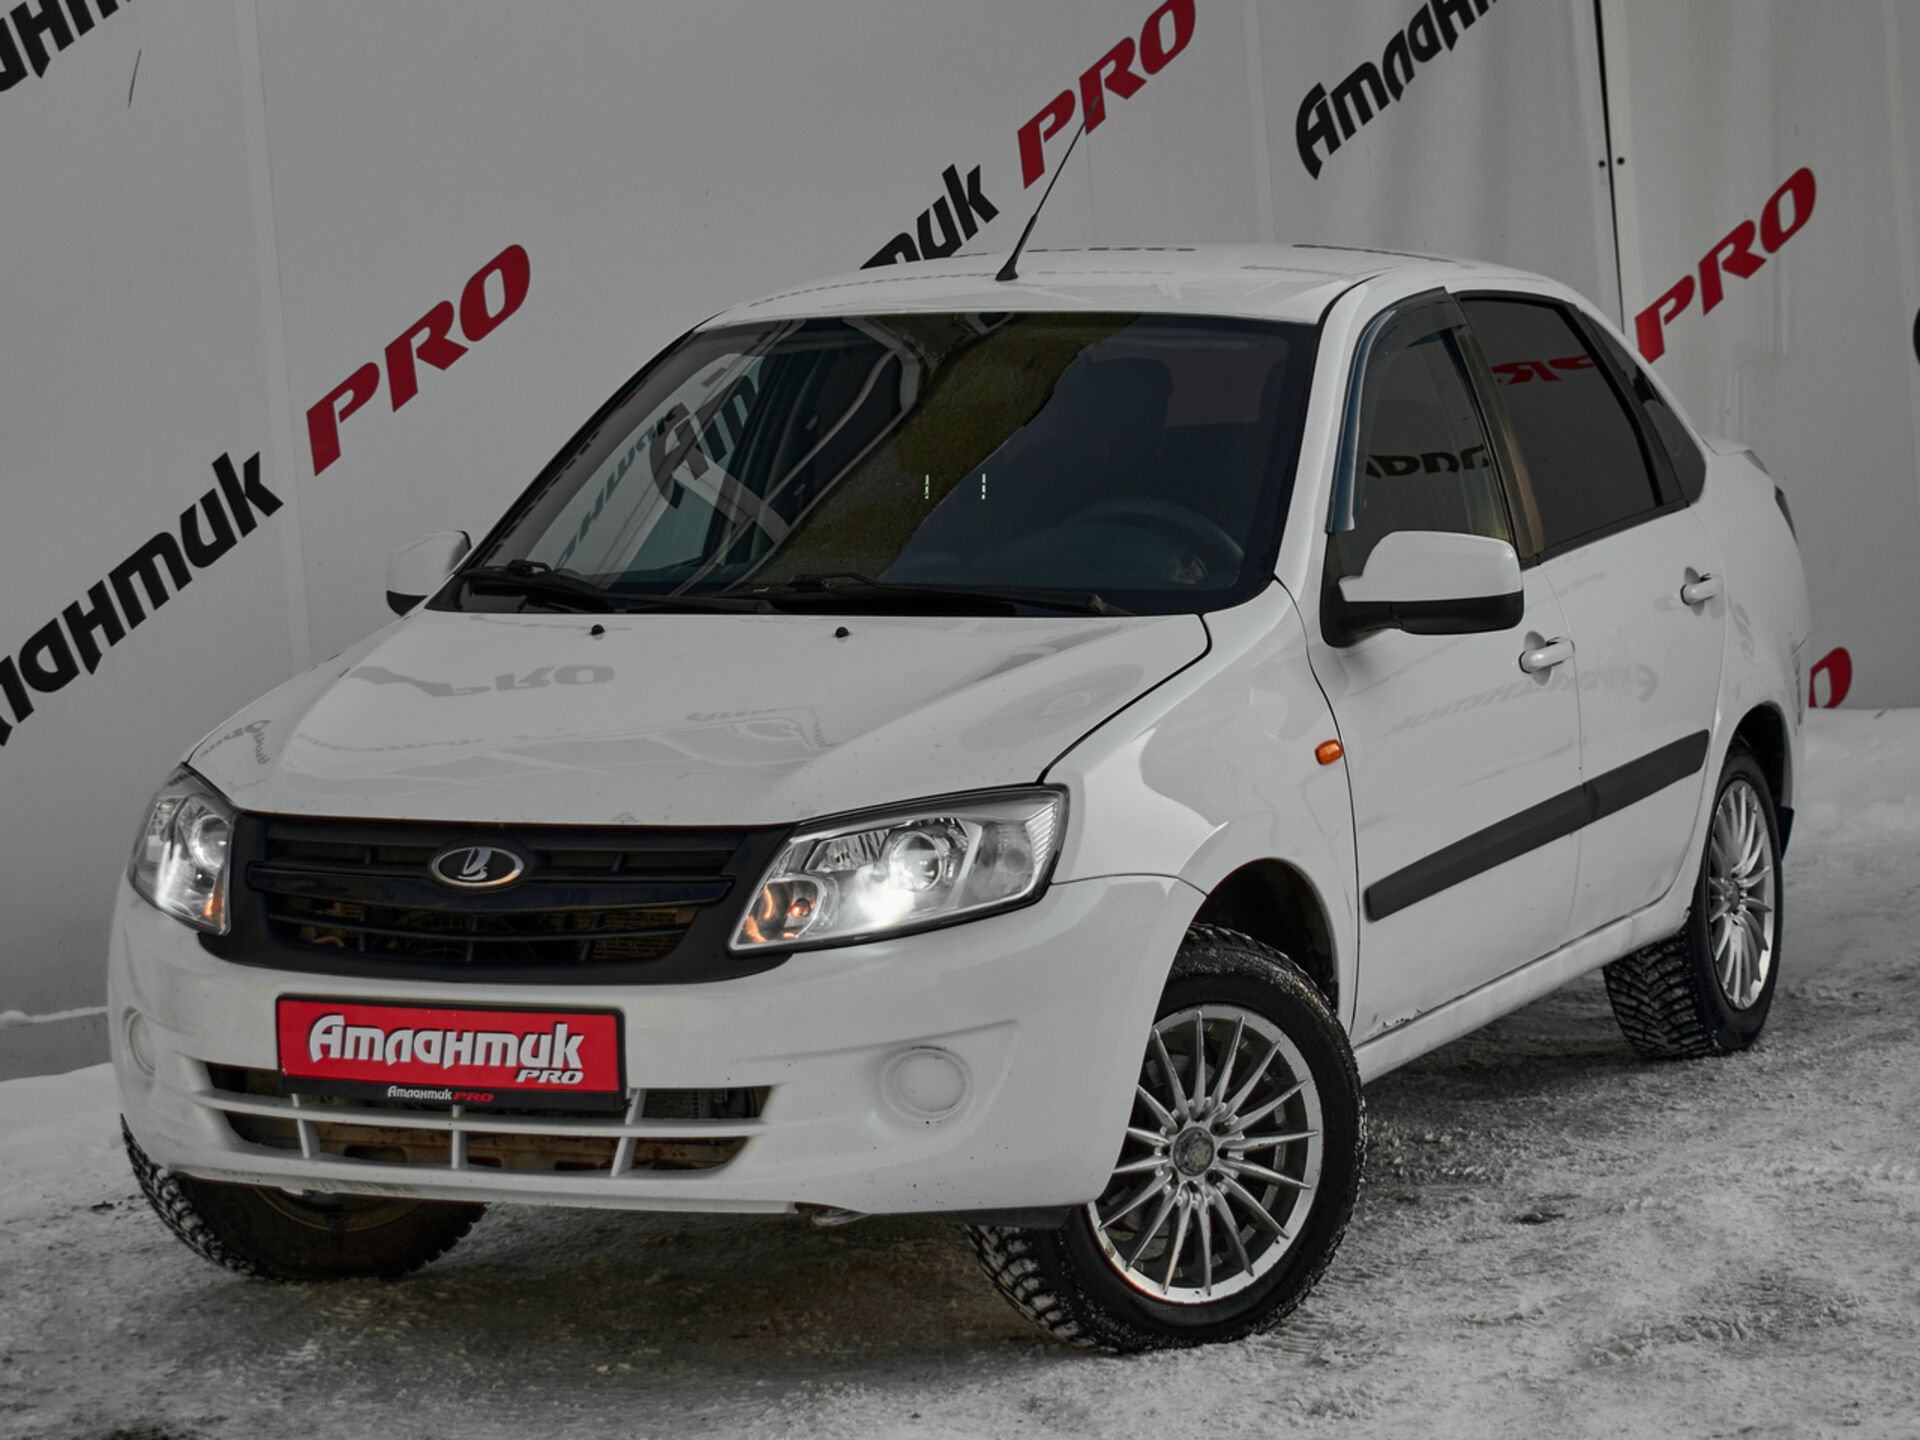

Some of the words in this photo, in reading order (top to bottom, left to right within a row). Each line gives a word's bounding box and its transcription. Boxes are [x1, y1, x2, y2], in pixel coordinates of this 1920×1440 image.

[1018, 0, 1195, 189] PRO
[306, 244, 531, 476] PRO
[1635, 167, 1816, 364] PRO
[452, 1091, 495, 1104] PRO
[515, 1068, 585, 1085] PRO
